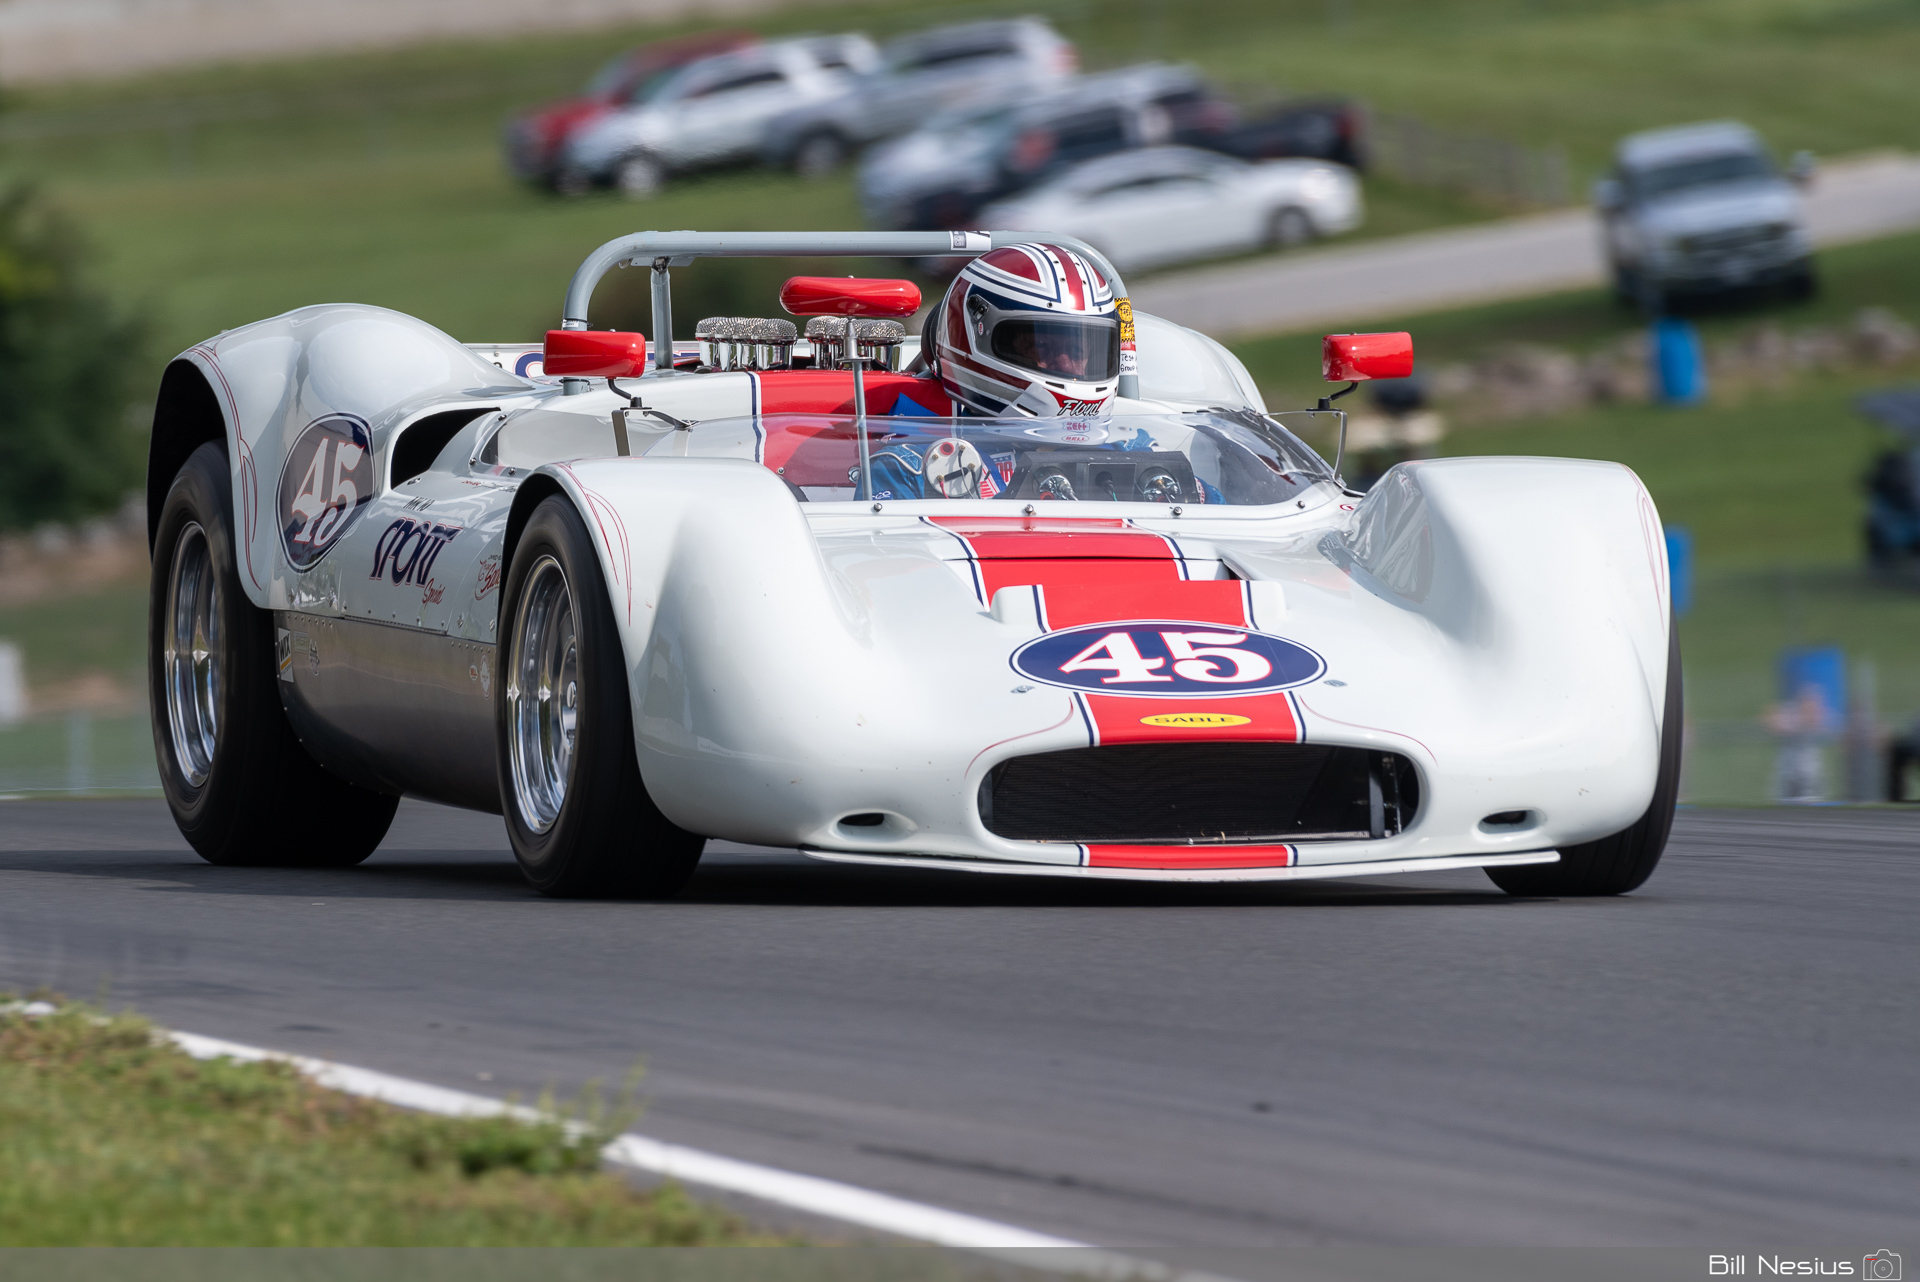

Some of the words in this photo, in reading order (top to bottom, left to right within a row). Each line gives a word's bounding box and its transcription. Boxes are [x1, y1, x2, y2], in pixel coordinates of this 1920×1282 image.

[292, 436, 366, 547] 45
[369, 516, 464, 588] SPORT
[1058, 631, 1273, 684] 45
